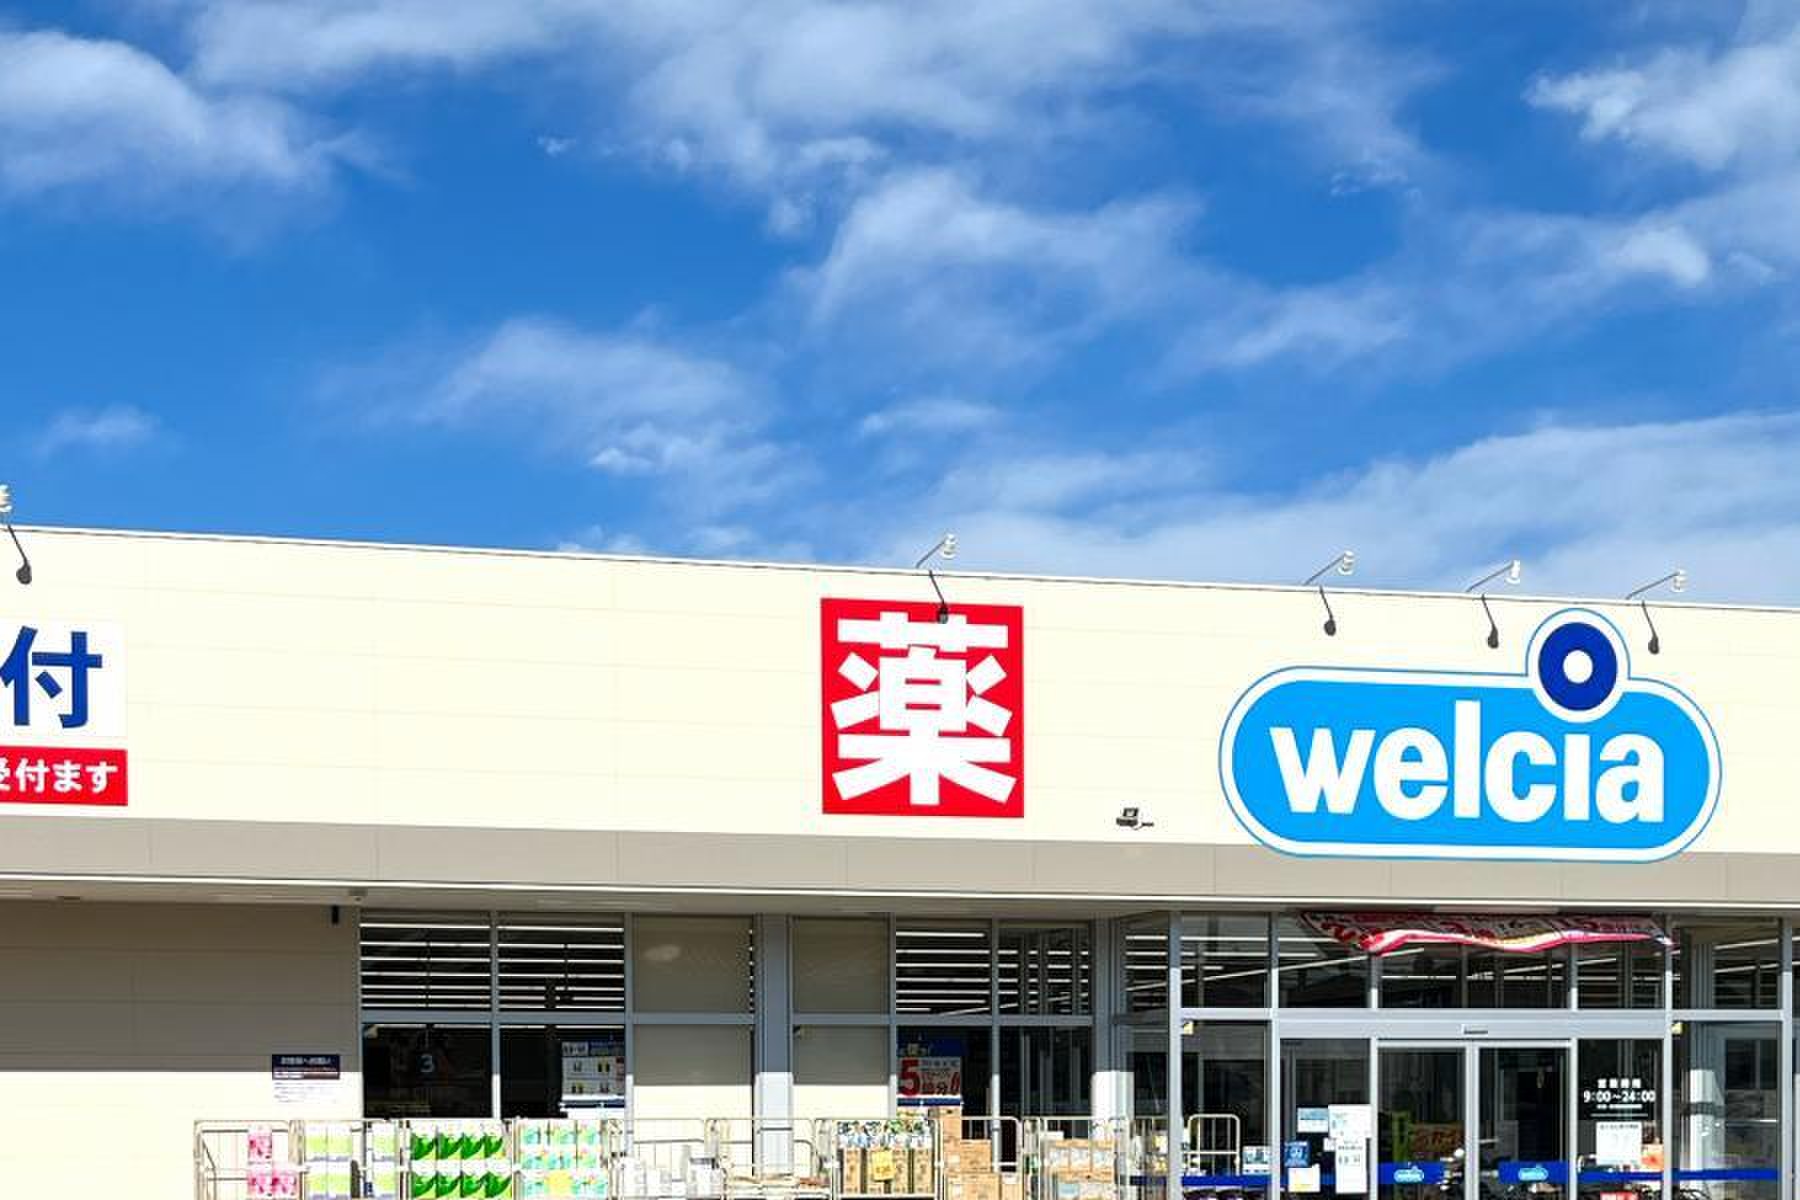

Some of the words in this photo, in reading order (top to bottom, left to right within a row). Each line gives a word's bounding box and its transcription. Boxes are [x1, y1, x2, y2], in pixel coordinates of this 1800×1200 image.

[0, 625, 103, 729] 付
[830, 611, 1016, 806] 薬
[1269, 621, 1665, 823] welcia
